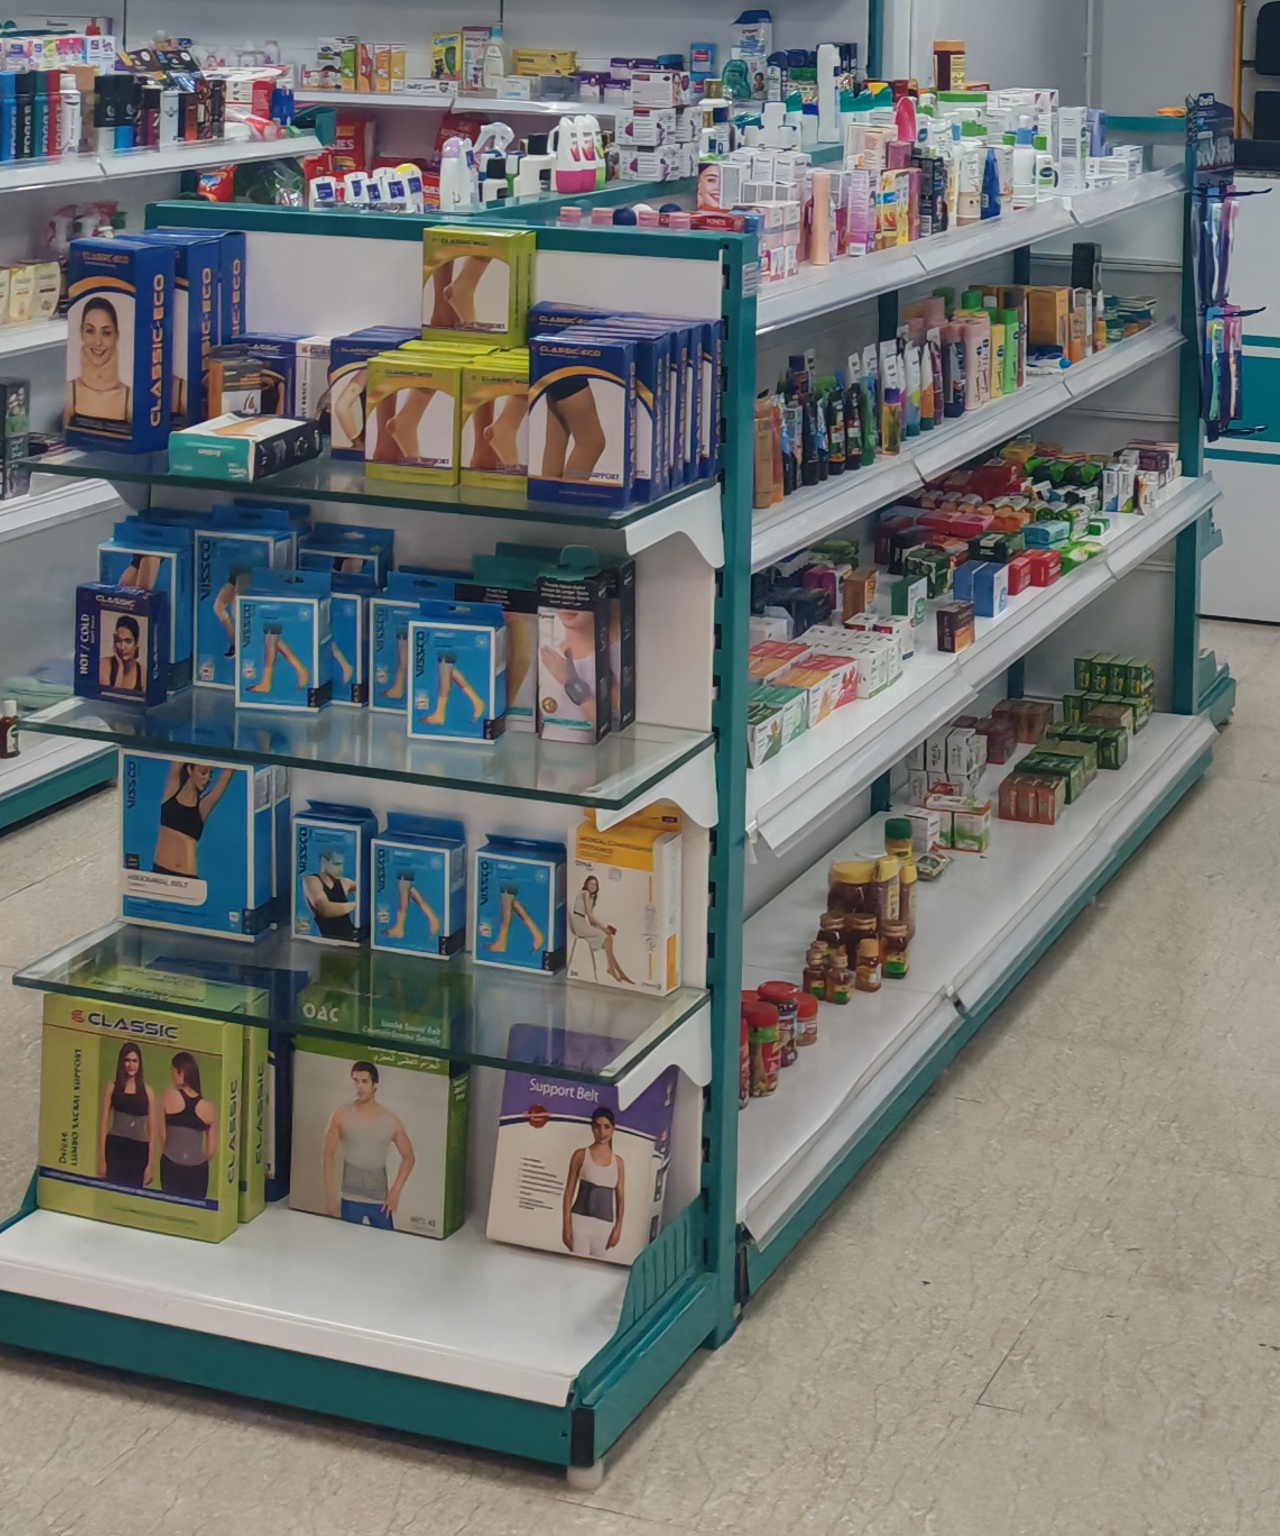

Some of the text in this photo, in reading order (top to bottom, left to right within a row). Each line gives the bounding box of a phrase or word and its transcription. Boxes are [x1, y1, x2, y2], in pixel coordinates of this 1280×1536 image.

[80, 614, 90, 642] COLD
[87, 1012, 180, 1040] CLASSIC
[529, 1079, 600, 1103] Support Belt
[255, 1062, 264, 1165] CLASSIC
[227, 1079, 238, 1184] CLASSIC
